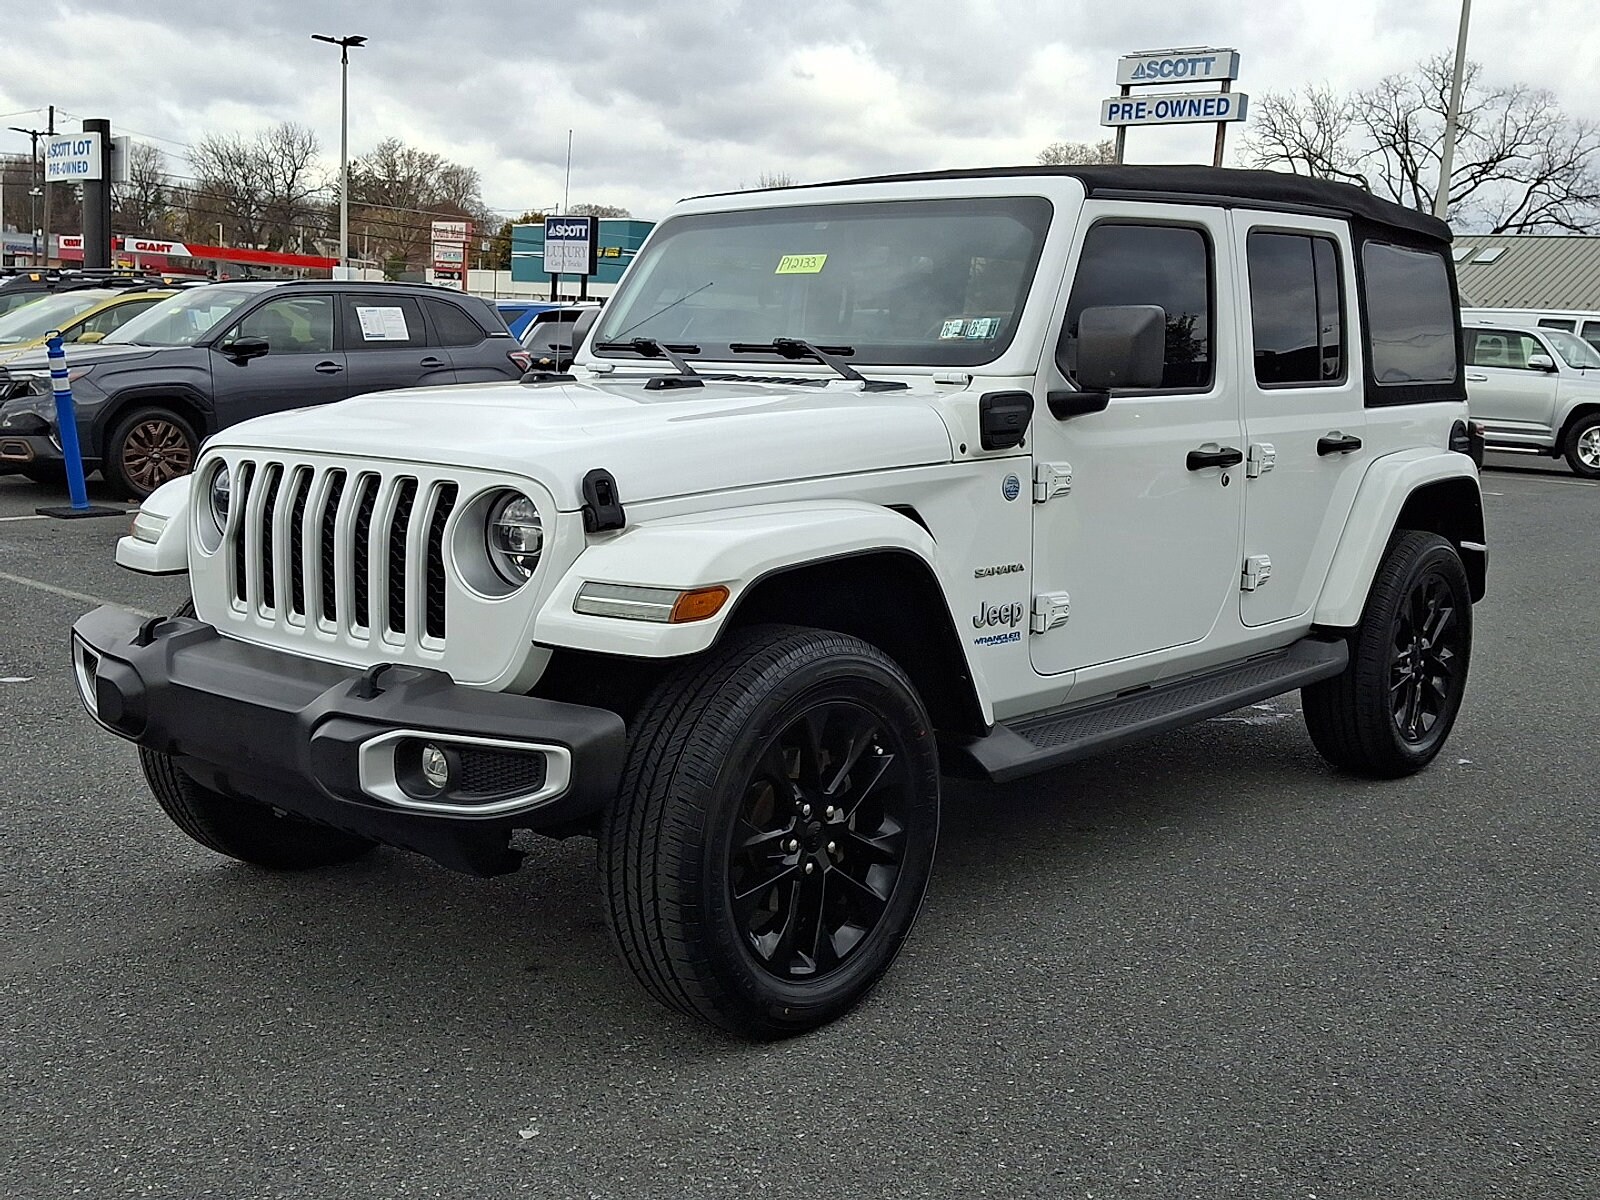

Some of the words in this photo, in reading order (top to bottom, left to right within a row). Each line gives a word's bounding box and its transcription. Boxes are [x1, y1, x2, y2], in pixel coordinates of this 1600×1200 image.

[1108, 97, 1230, 121] PRE-OWNED
[73, 140, 92, 156] LOT
[48, 160, 88, 175] PRE-OWNED
[135, 241, 173, 254] GIANT
[546, 245, 588, 258] LUXURY
[779, 256, 817, 272] P12133
[974, 563, 1024, 579] SAHARA
[972, 601, 1024, 629] Jeep
[974, 631, 1021, 645] WRANGLER
